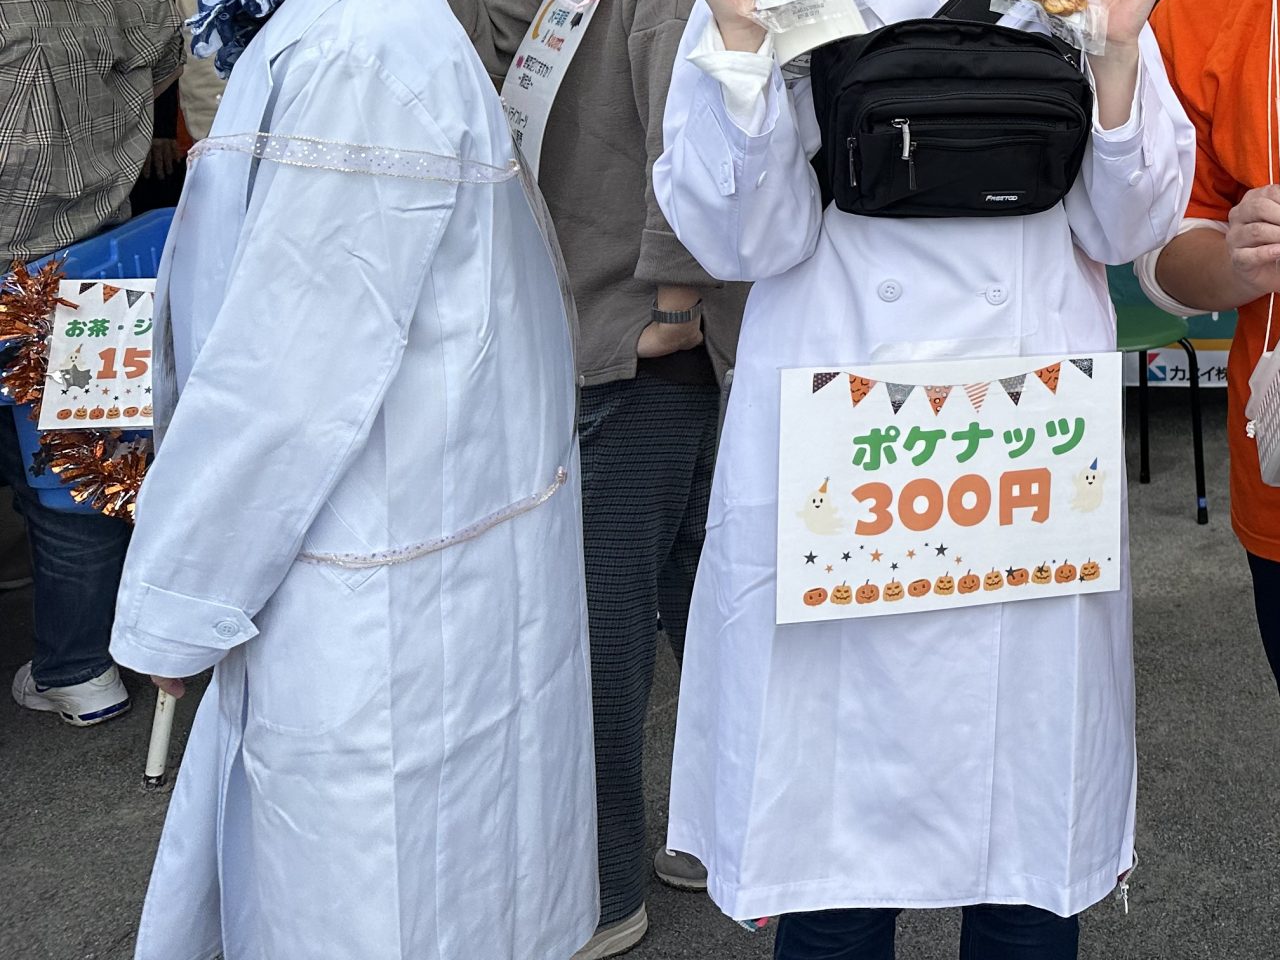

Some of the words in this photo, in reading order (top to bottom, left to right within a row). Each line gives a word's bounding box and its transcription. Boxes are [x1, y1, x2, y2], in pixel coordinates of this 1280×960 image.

[96, 347, 151, 380] 15
[851, 417, 1086, 471] ポケナッツ
[851, 467, 1052, 536] 300円
